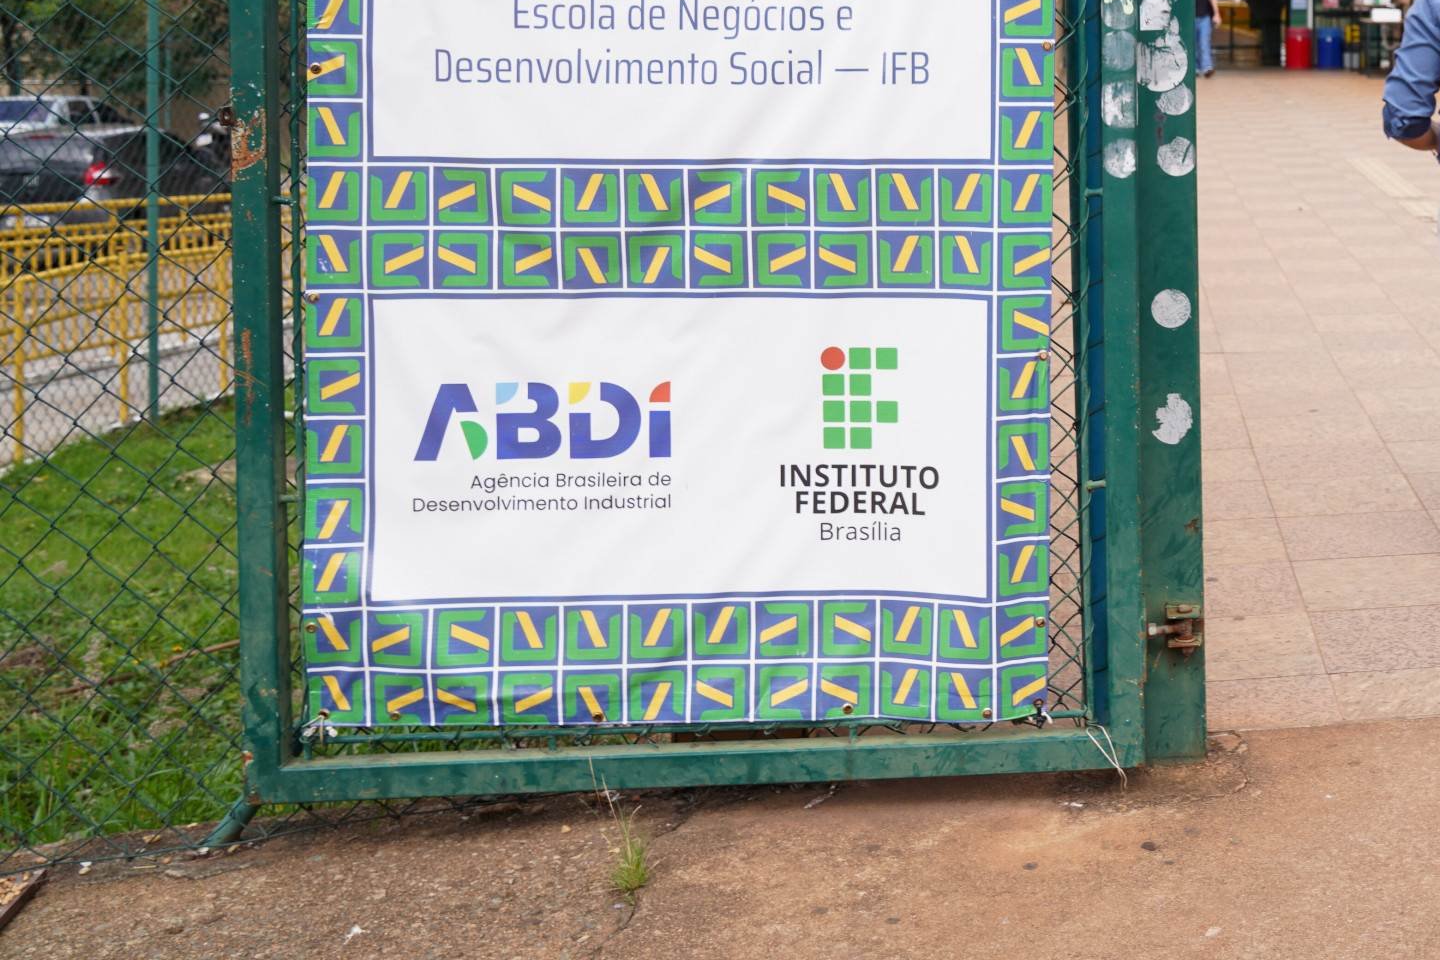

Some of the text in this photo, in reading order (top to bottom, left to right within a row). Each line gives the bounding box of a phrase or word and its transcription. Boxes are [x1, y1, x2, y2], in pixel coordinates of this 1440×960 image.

[836, 5, 853, 31] e
[435, 49, 718, 85] Desenvolvimento
[729, 50, 822, 86] Social
[881, 52, 929, 85] IFB
[470, 471, 672, 494] Agência Brasileira de
[780, 464, 940, 489] INSTITUTO
[412, 493, 671, 513] Desenvolvimento Industrial
[795, 490, 926, 516] FEDERAL
[820, 520, 901, 542] Brasília
